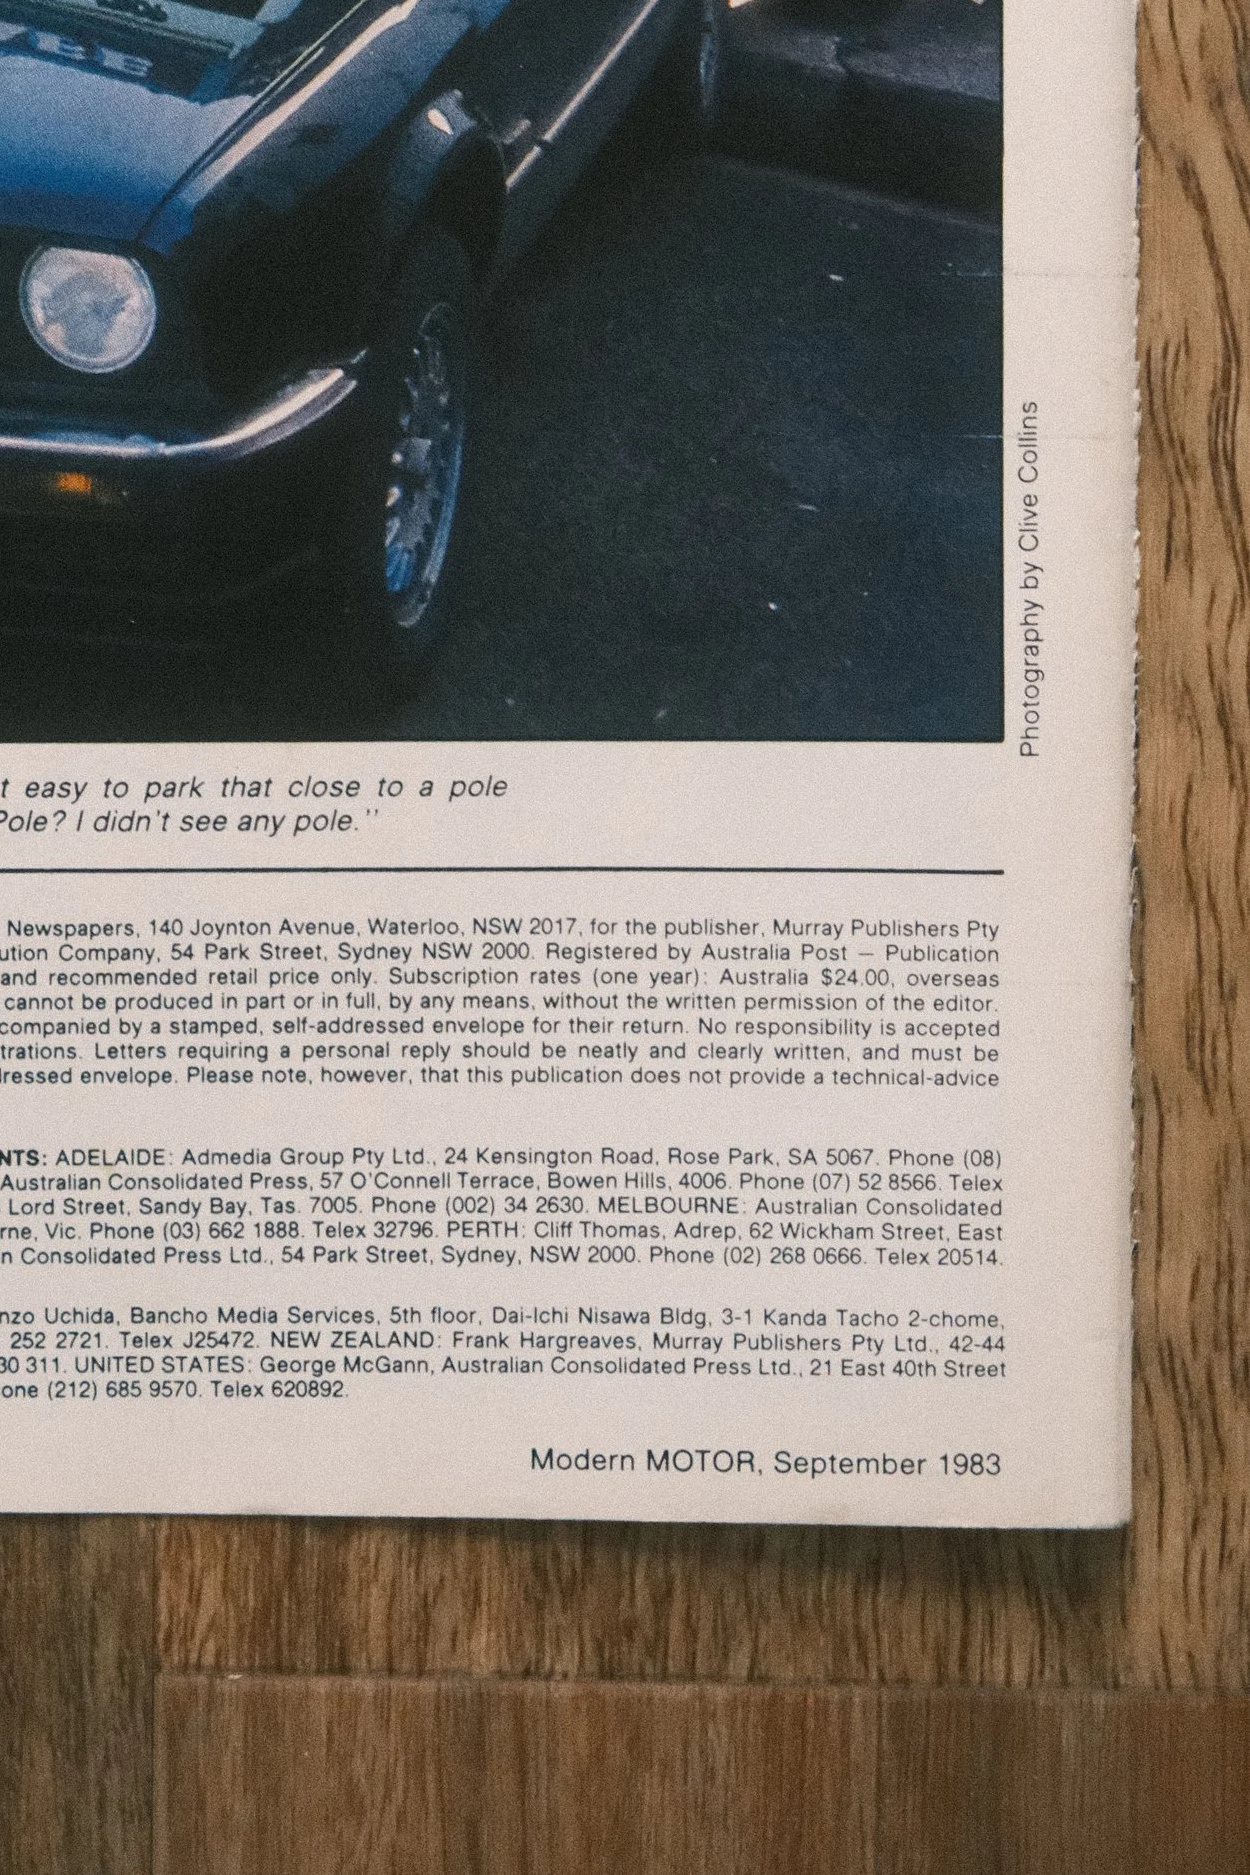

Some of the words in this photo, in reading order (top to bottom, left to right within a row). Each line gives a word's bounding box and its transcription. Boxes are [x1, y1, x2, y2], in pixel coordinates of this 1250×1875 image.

[1018, 401, 1038, 483] Collins
[1018, 494, 1038, 552] Clive
[1020, 562, 1043, 589] by
[1019, 599, 1044, 757] Photography
[24, 781, 87, 804] easy
[103, 778, 128, 798] to
[143, 776, 204, 803] park
[221, 776, 272, 797] that
[288, 775, 360, 797] close
[378, 777, 403, 797] to
[418, 780, 433, 796] a
[448, 775, 507, 801] pole
[76, 809, 84, 833] I
[93, 809, 170, 833] didn't
[179, 814, 228, 832] see
[237, 813, 285, 838] any
[7, 920, 139, 939] Newspapers,
[150, 918, 182, 935] 140
[190, 919, 270, 939] Joynton
[279, 918, 359, 935] Avenue,
[367, 918, 463, 935] Waterloo,
[473, 917, 522, 934] NSW
[529, 917, 581, 935] 2017,
[590, 918, 616, 934] for
[625, 919, 655, 934] the
[665, 919, 763, 938] publisher,
[773, 919, 842, 939] Murray
[851, 919, 958, 936] Publishers
[967, 920, 998, 941] Pty
[119, 1018, 141, 1038] by
[150, 1021, 160, 1033] a
[170, 1017, 262, 1037] stamped,
[273, 1017, 423, 1033] self-addressed
[432, 1017, 523, 1036] envelope
[533, 1016, 559, 1033] for
[569, 1017, 613, 1033] their
[623, 1019, 687, 1033] return.
[699, 1017, 726, 1034] No
[735, 1019, 871, 1038] responsibility
[880, 1022, 895, 1035] is
[905, 1021, 999, 1039] accepted
[55, 1148, 169, 1166] ADELAIDE:
[182, 1149, 270, 1164] Admedia
[280, 1147, 343, 1167] Group
[353, 1147, 383, 1168] Pty
[393, 1148, 435, 1165] Ltd.,
[445, 1147, 467, 1164] 24
[476, 1147, 591, 1168] Kensington
[601, 1147, 658, 1164] Road,
[668, 1147, 719, 1164] Rose
[729, 1147, 778, 1165] Park,
[789, 1148, 816, 1165] SA
[826, 1148, 878, 1165] 5067.
[889, 1149, 953, 1166] Phone
[964, 1149, 1000, 1168] (08)
[44, 1307, 119, 1325] Uchida,
[130, 1306, 207, 1323] Bancho
[218, 1307, 277, 1323] Media
[287, 1306, 379, 1324] Services,
[390, 1306, 420, 1323] 5th
[431, 1306, 481, 1324] floor,
[492, 1306, 567, 1323] Dai-Ichi
[578, 1307, 649, 1324] Nisawa
[660, 1307, 710, 1328] Bldg,
[722, 1308, 750, 1324] 3-1
[764, 1309, 826, 1325] Kanda
[836, 1309, 898, 1326] Tacho
[909, 1310, 1003, 1328] 2-chome,
[48, 1380, 96, 1400] (212)
[106, 1380, 141, 1397] 685
[149, 1380, 201, 1397] 9570.
[210, 1380, 263, 1397] Telex
[271, 1380, 348, 1397] 620892.
[531, 1448, 634, 1470] Modern
[647, 1449, 761, 1474] MOTOR,
[774, 1450, 926, 1478] September
[940, 1453, 1000, 1475] 1983
